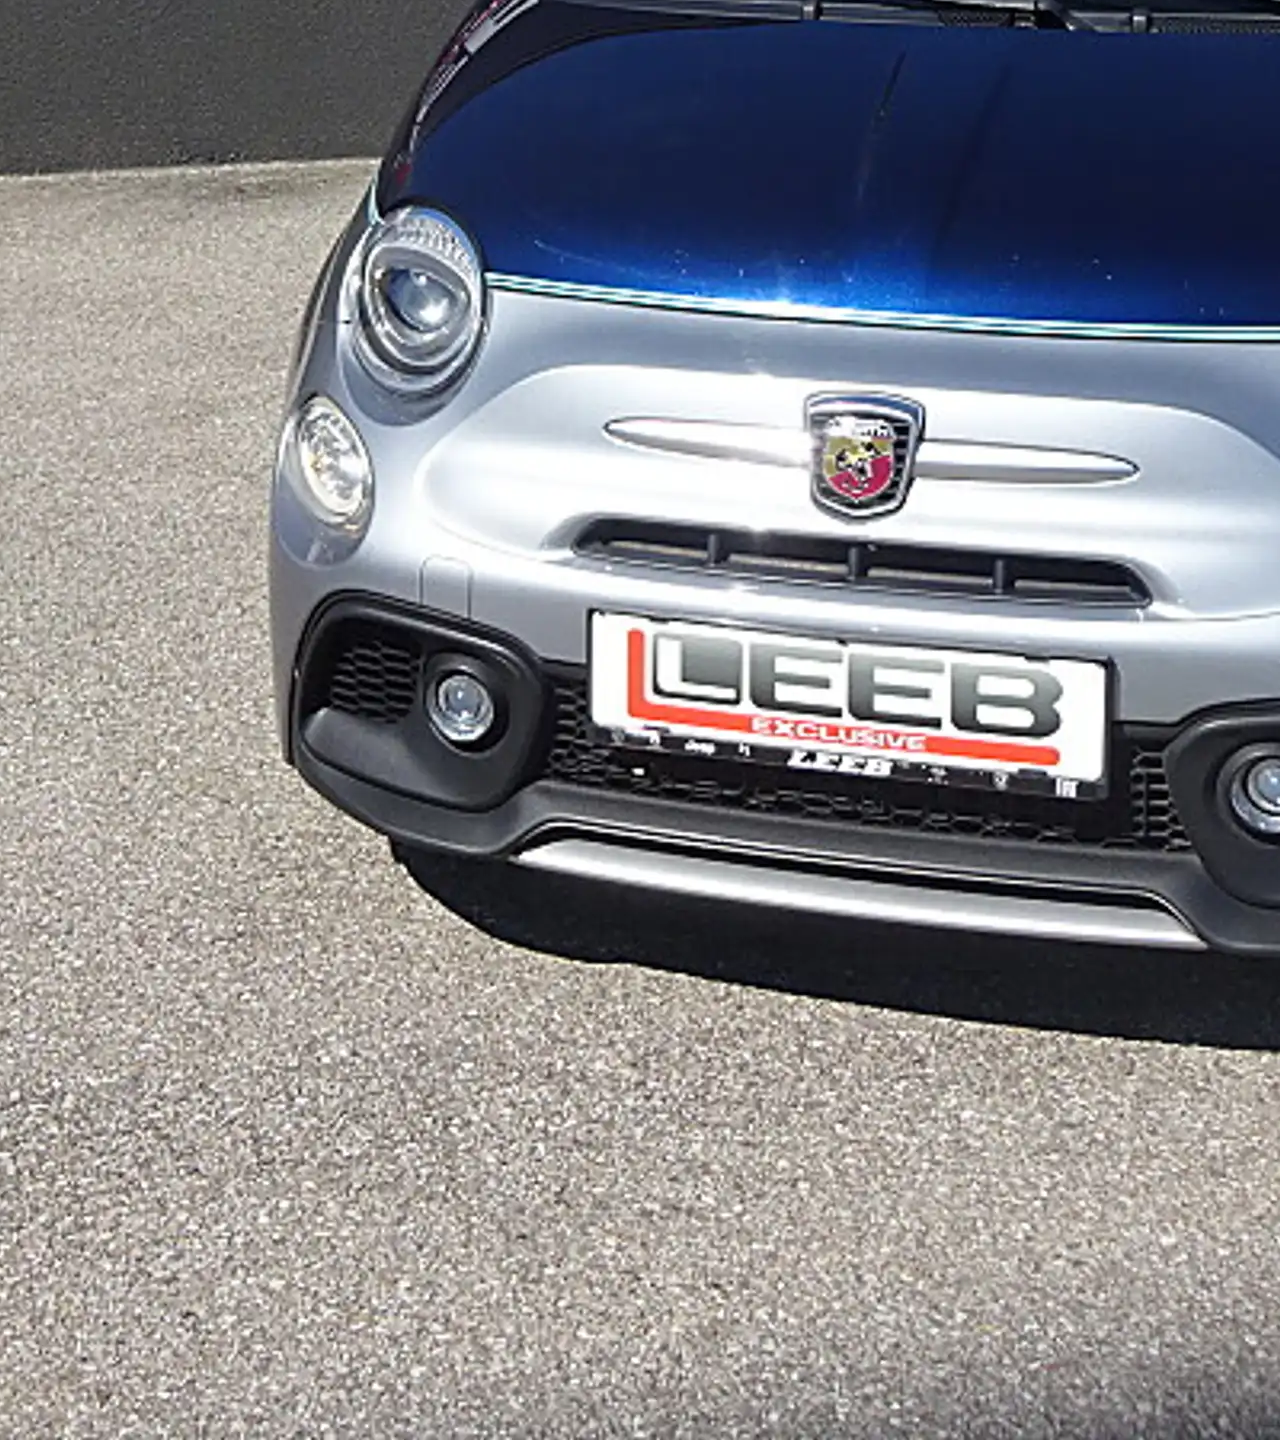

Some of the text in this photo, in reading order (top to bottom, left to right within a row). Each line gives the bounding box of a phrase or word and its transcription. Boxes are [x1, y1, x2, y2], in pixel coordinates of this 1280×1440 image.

[652, 631, 1064, 738] LEEB
[751, 715, 927, 753] EXCLUSIVE
[786, 748, 894, 778] LEEB
